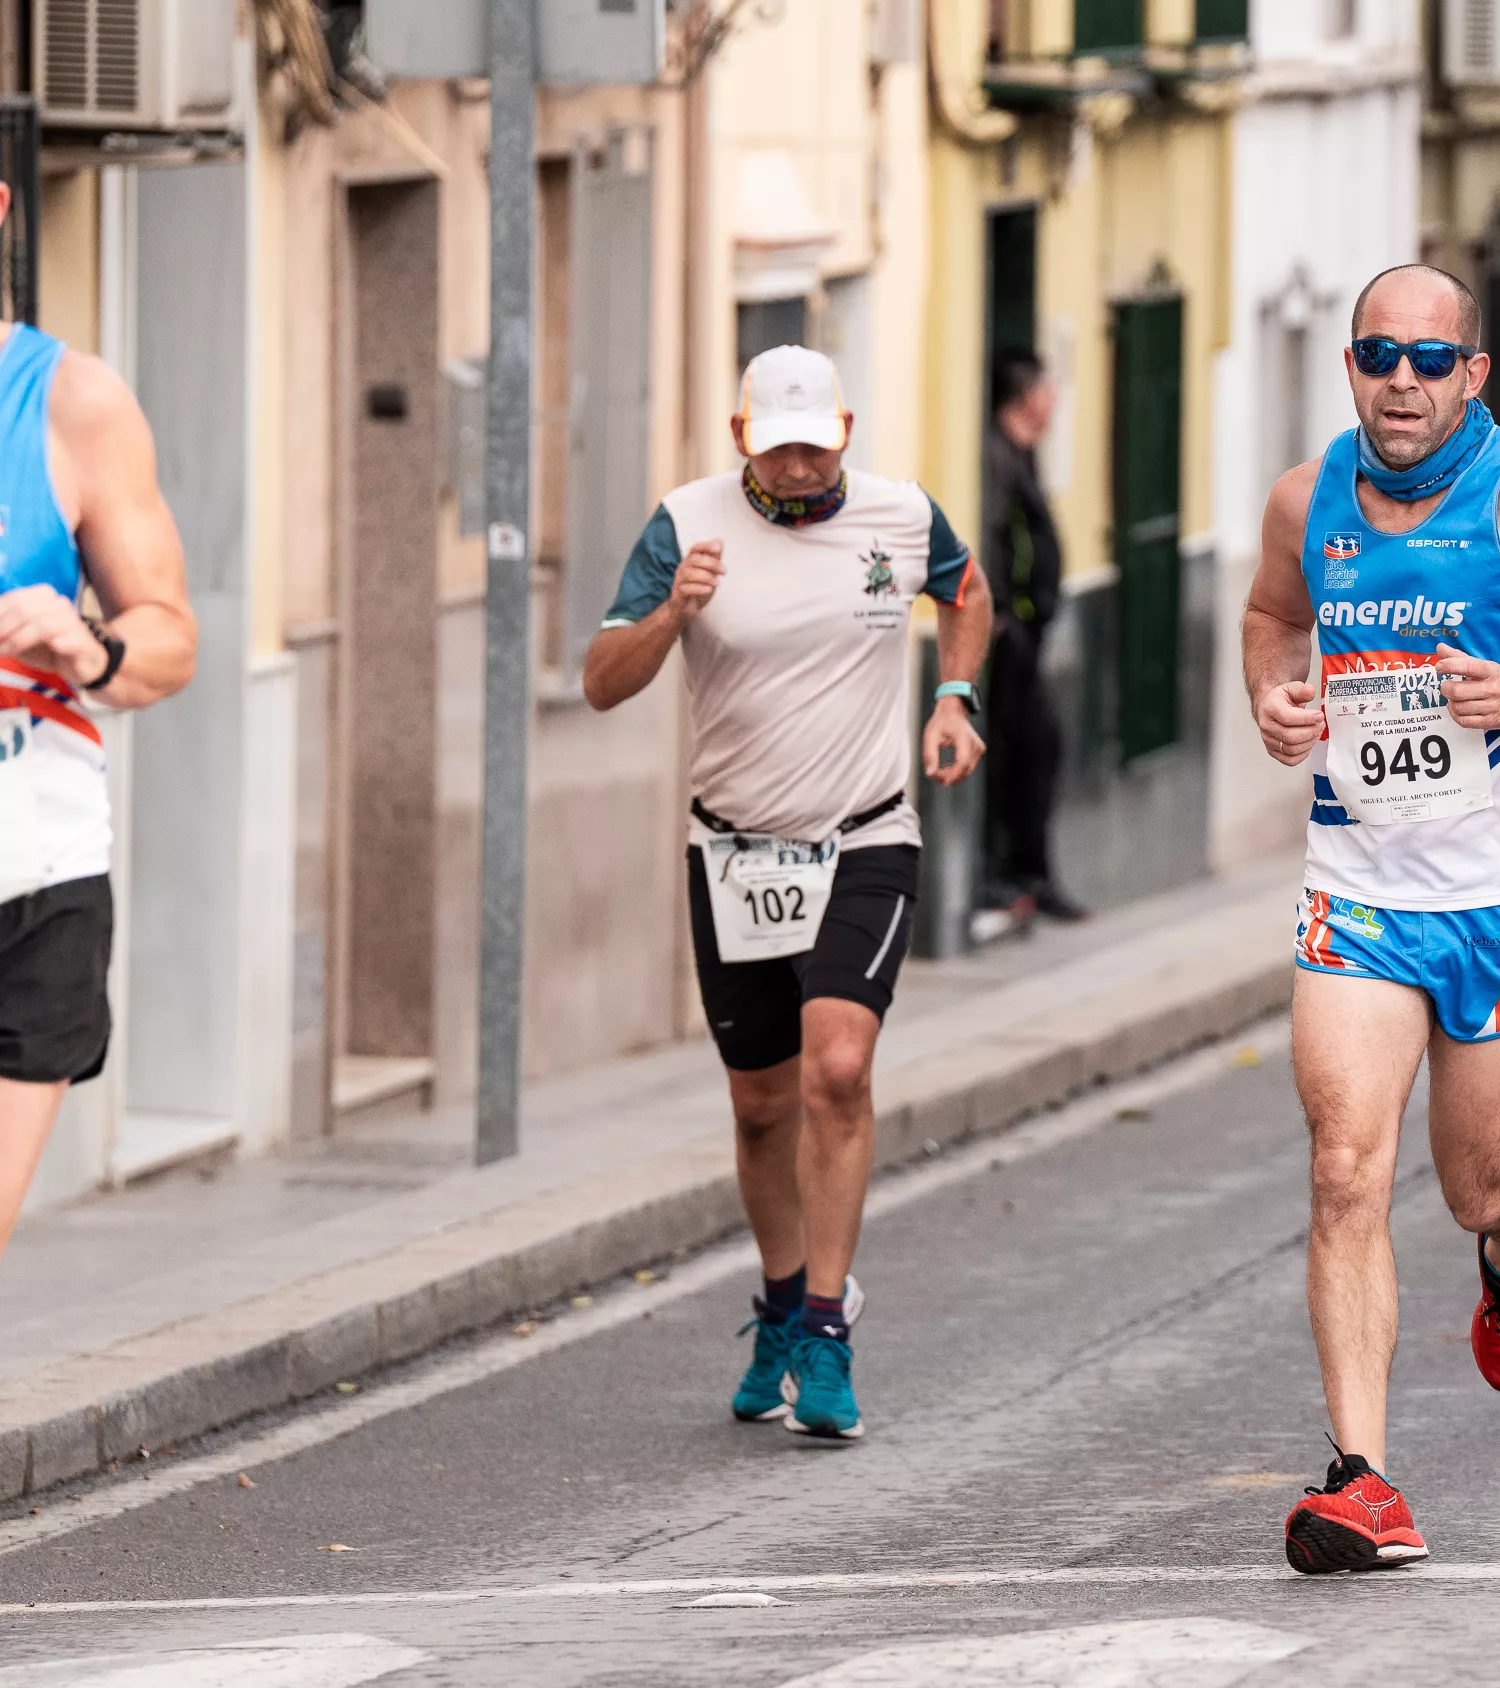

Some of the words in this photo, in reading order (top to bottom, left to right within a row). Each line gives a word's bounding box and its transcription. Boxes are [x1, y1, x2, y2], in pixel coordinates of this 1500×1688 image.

[1407, 539, 1457, 548] GSPORT
[1325, 559, 1345, 570] Club
[1324, 578, 1354, 589] Lucena
[1400, 625, 1459, 637] directo
[1329, 680, 1351, 689] CIRCUITO
[1353, 677, 1386, 687] PROVINCIAL
[1388, 676, 1396, 685] DE
[1398, 671, 1440, 692] 2024
[1329, 687, 1358, 697] CARRERAS
[1360, 684, 1397, 695] POPULARES
[1385, 718, 1406, 726] CIUDAD
[1416, 714, 1442, 723] LUCENA
[1395, 725, 1426, 734] IGUALDAD
[1360, 734, 1451, 787] 949
[1360, 797, 1384, 805] MIGUEL
[1386, 795, 1408, 803] ANGEL
[1410, 791, 1433, 801] ARCOS
[1434, 788, 1462, 798] CORTES
[745, 885, 806, 925] 102
